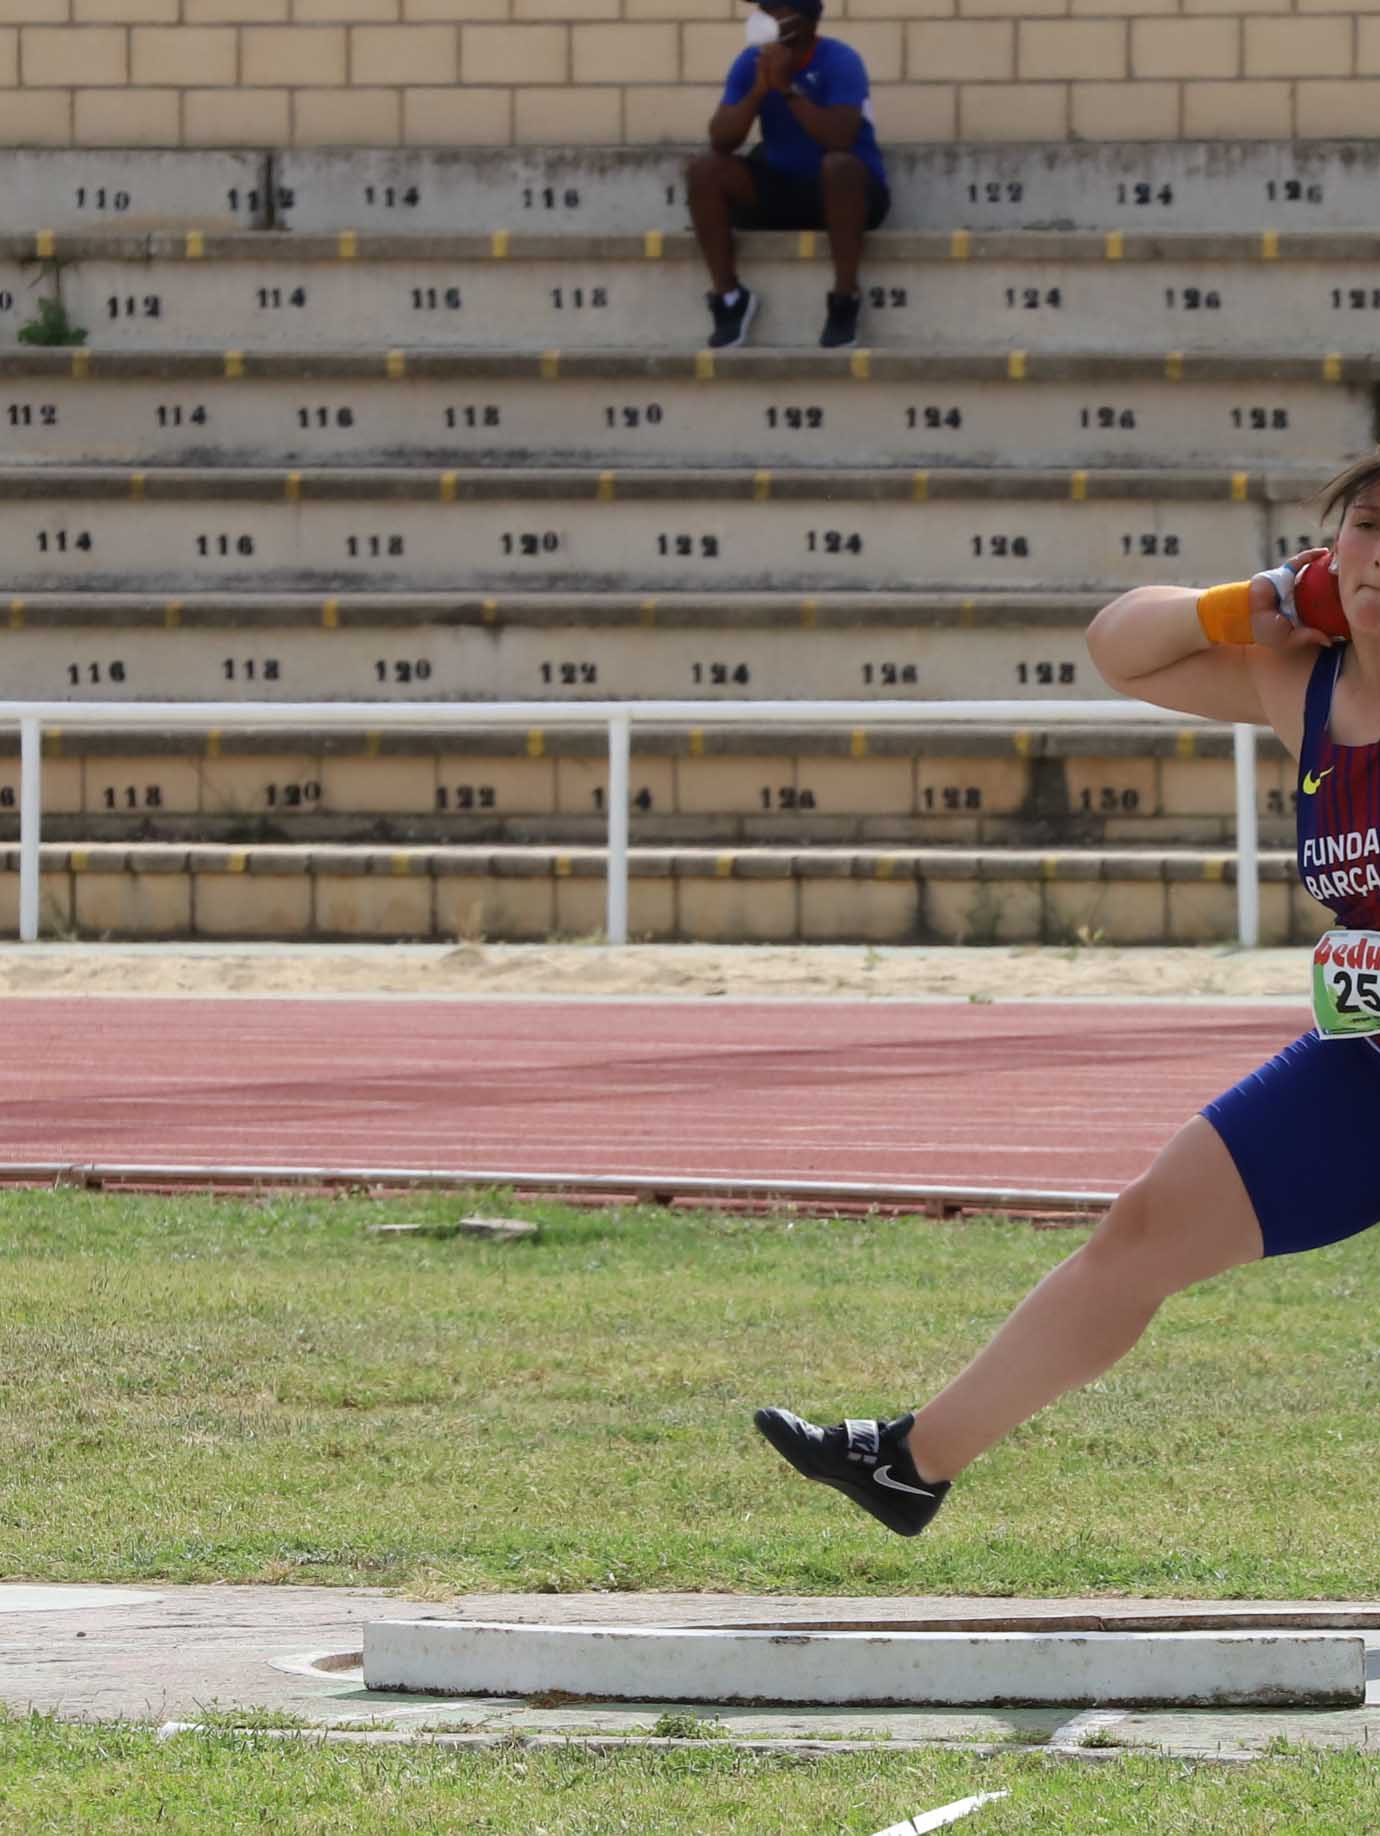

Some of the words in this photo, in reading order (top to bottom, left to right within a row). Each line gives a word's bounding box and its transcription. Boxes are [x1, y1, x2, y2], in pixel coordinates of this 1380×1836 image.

[76, 186, 129, 210] 110
[364, 186, 420, 207] 114
[522, 186, 578, 210] 116
[968, 183, 1023, 204] 122
[1117, 183, 1172, 205] 124
[1267, 181, 1322, 205] 126
[107, 295, 160, 319] 112
[257, 288, 305, 309] 114
[411, 288, 460, 310] 116
[552, 288, 606, 309] 118
[1005, 288, 1061, 309] 124
[1165, 288, 1221, 310] 126
[8, 404, 56, 426] 112
[157, 404, 206, 427] 114
[297, 406, 353, 429] 116
[444, 407, 500, 429] 118
[605, 403, 662, 428] 120
[766, 407, 823, 429] 122
[906, 407, 961, 429] 124
[1080, 407, 1135, 430] 126
[1231, 407, 1288, 431] 128
[37, 530, 92, 552] 114
[197, 535, 254, 556] 116
[347, 535, 403, 556] 118
[502, 531, 559, 554] 120
[658, 533, 718, 556] 122
[806, 530, 861, 553] 124
[973, 535, 1028, 556] 126
[1122, 533, 1179, 555] 128
[69, 661, 126, 684] 116
[222, 658, 279, 680] 118
[375, 658, 431, 682] 120
[541, 662, 597, 683] 122
[692, 662, 749, 684] 124
[863, 663, 917, 684] 126
[1017, 662, 1074, 684] 128
[104, 786, 161, 807] 118
[265, 781, 321, 805] 120
[437, 785, 494, 807] 122
[593, 787, 652, 809] 14
[760, 787, 815, 809] 126
[923, 787, 982, 809] 128
